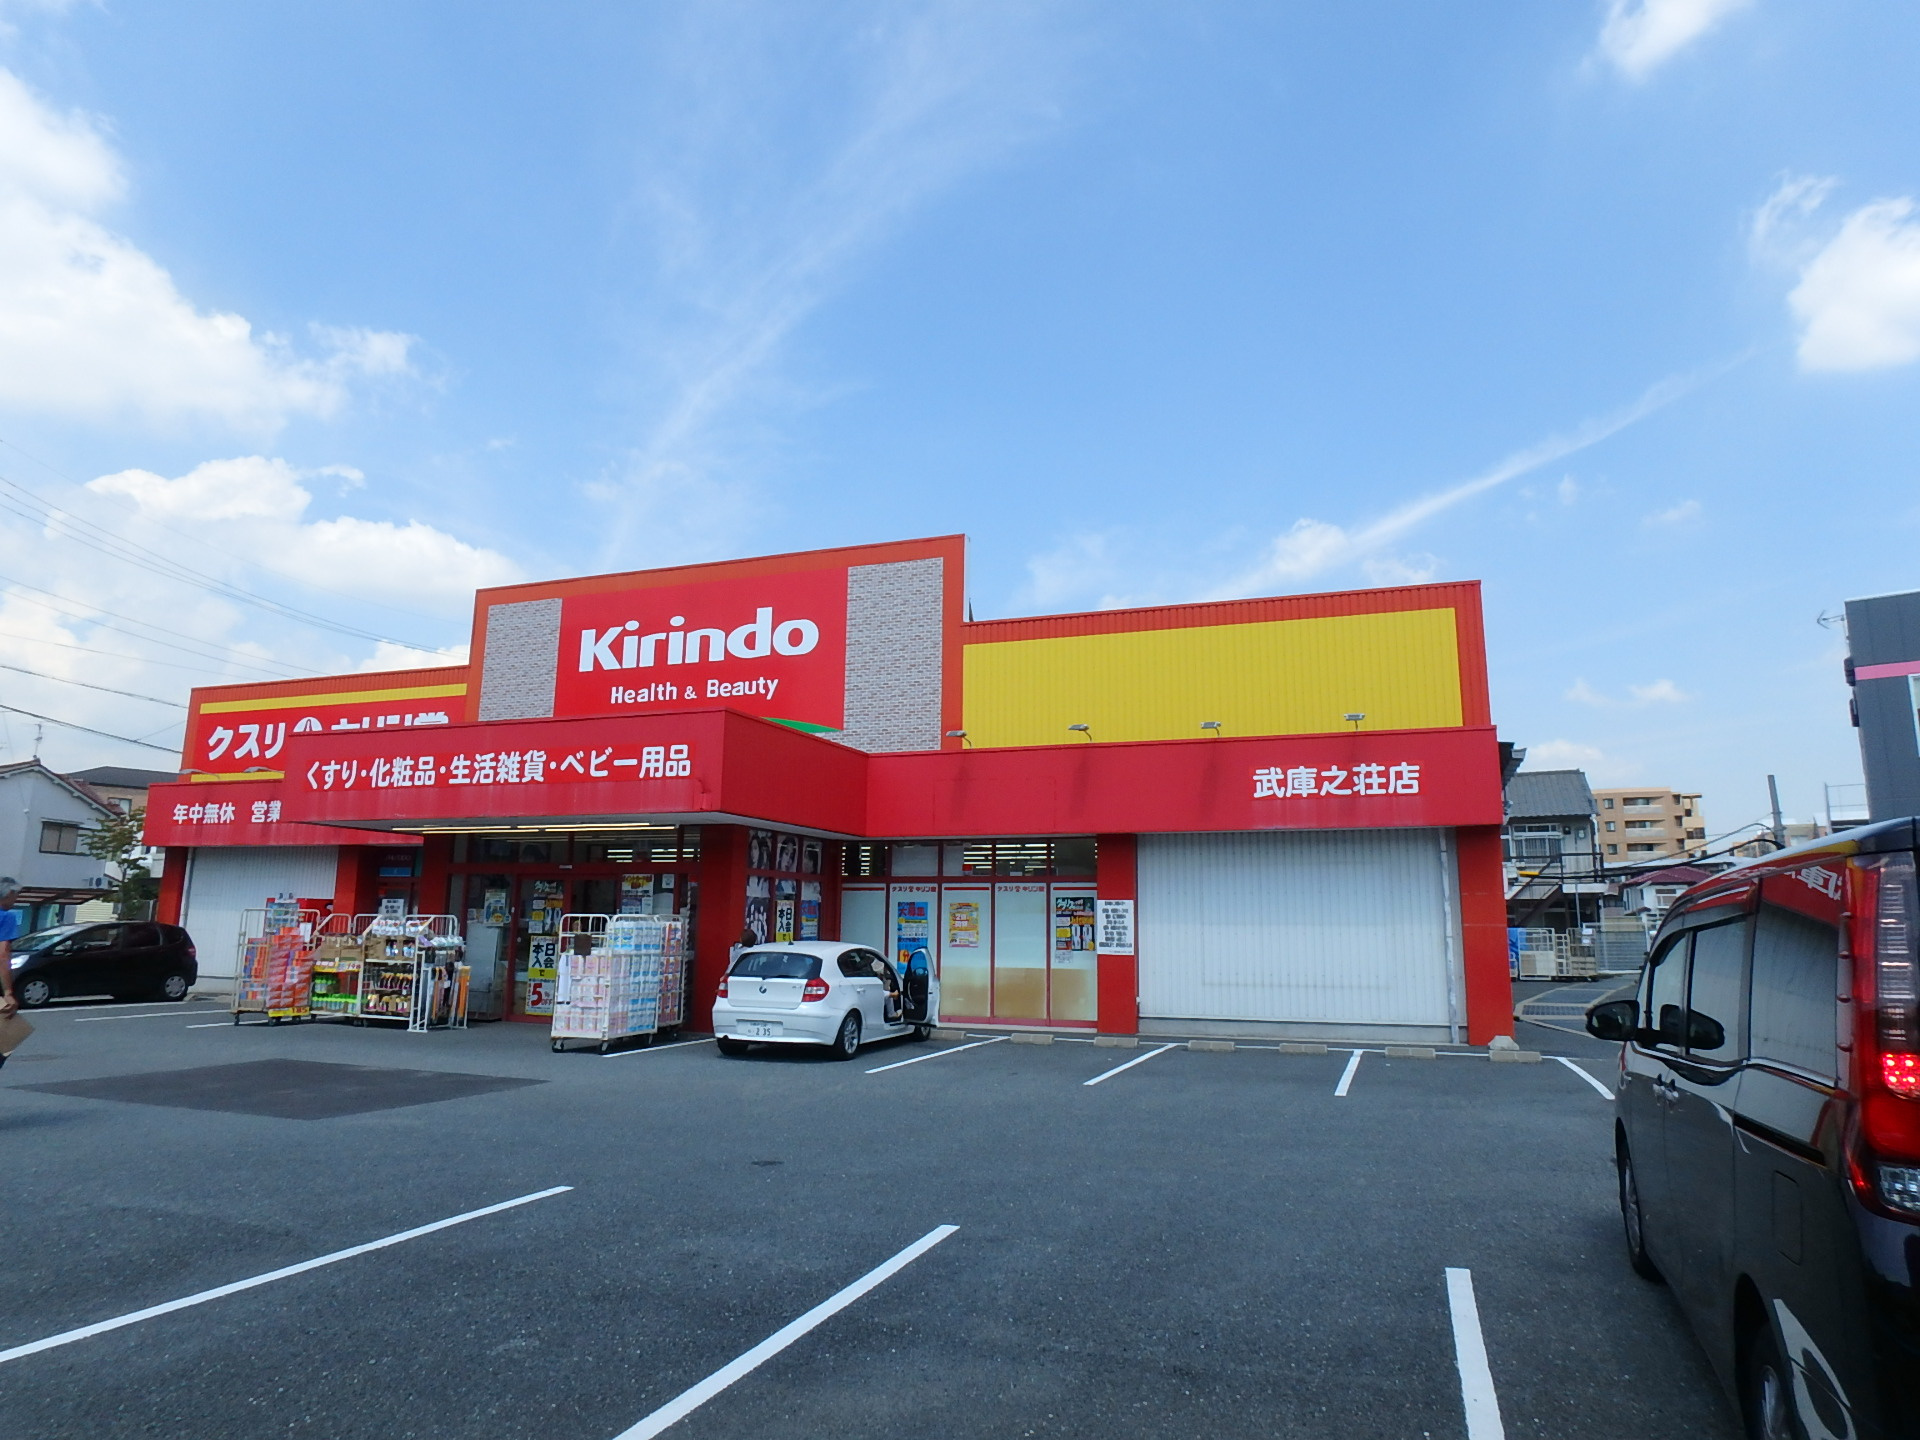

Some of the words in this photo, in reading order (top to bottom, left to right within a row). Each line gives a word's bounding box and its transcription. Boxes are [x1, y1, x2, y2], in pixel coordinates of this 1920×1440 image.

[579, 606, 820, 673] Kirindo
[610, 681, 678, 704] Health
[684, 685, 698, 700] &
[706, 676, 779, 700] Beauty
[207, 722, 286, 761] クスリ
[1252, 761, 1420, 798] 武庫之荘店
[172, 802, 236, 824] 年中無休
